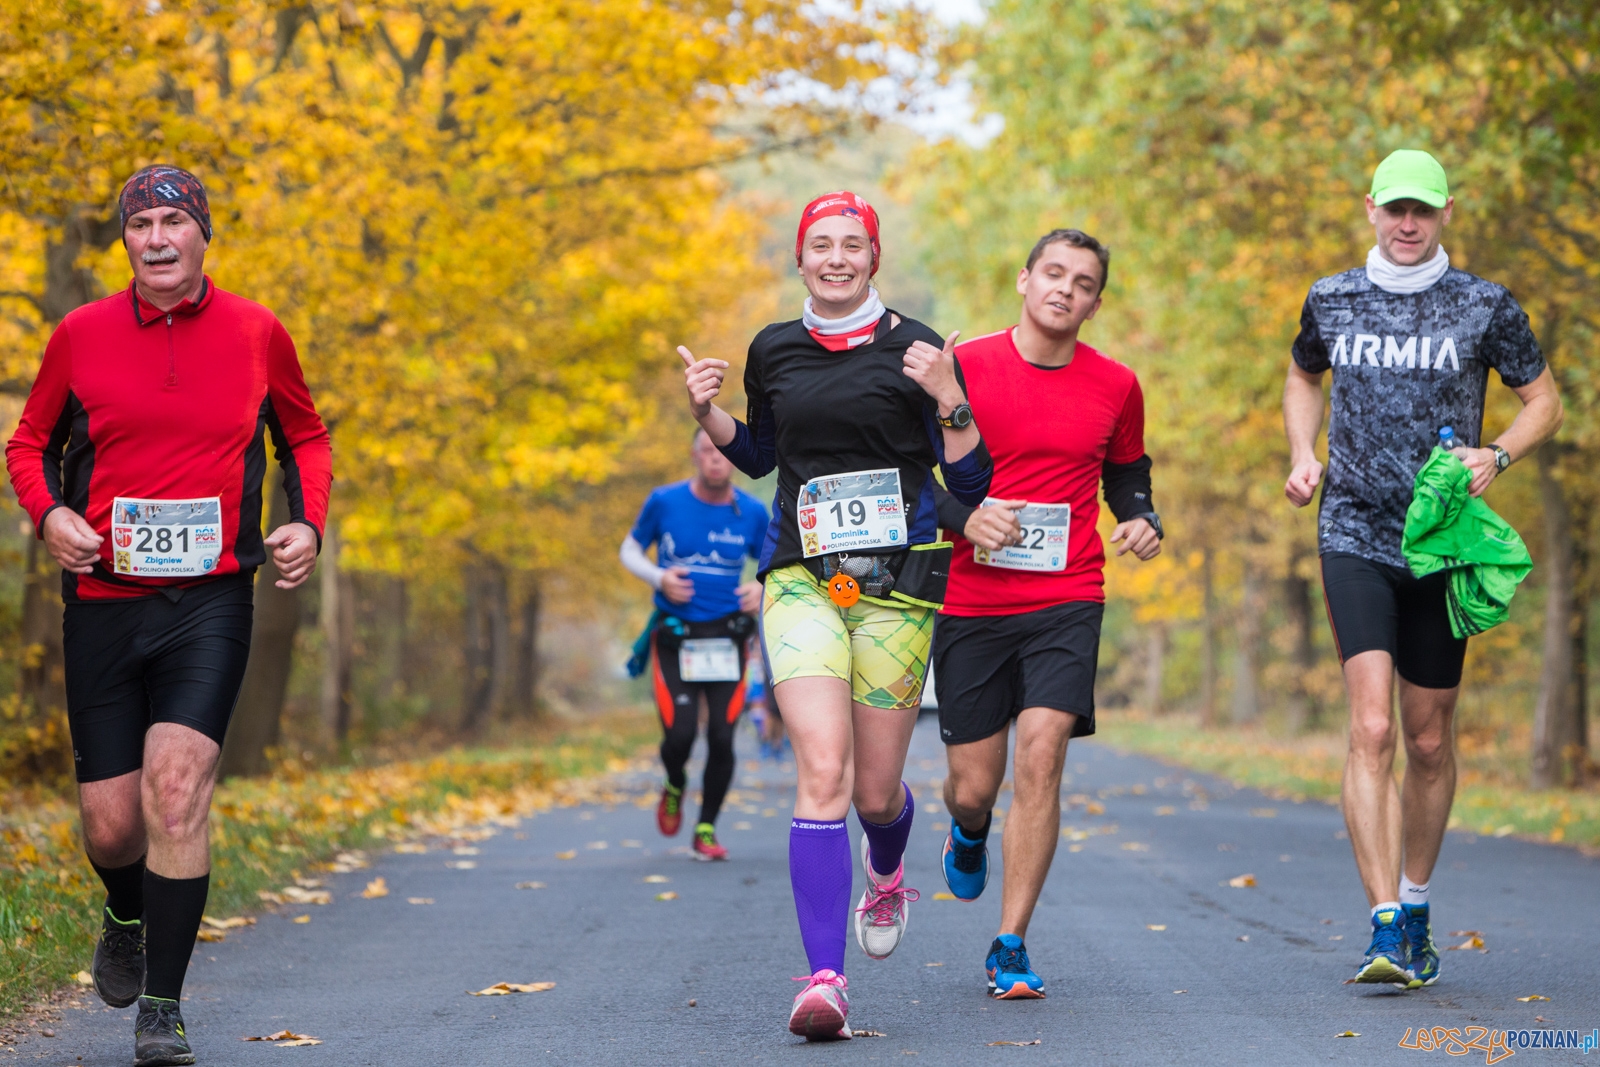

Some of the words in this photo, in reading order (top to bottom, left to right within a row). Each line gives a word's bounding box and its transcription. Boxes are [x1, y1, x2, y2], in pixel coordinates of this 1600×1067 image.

[1331, 334, 1460, 371] ARMIA
[830, 500, 866, 527] 19
[136, 527, 188, 553] 281
[831, 529, 869, 540] Dominika
[1013, 527, 1045, 550] 22
[827, 541, 857, 549] POLINOVA
[145, 556, 183, 565] Zbigniew
[1005, 550, 1032, 559] Tomasz
